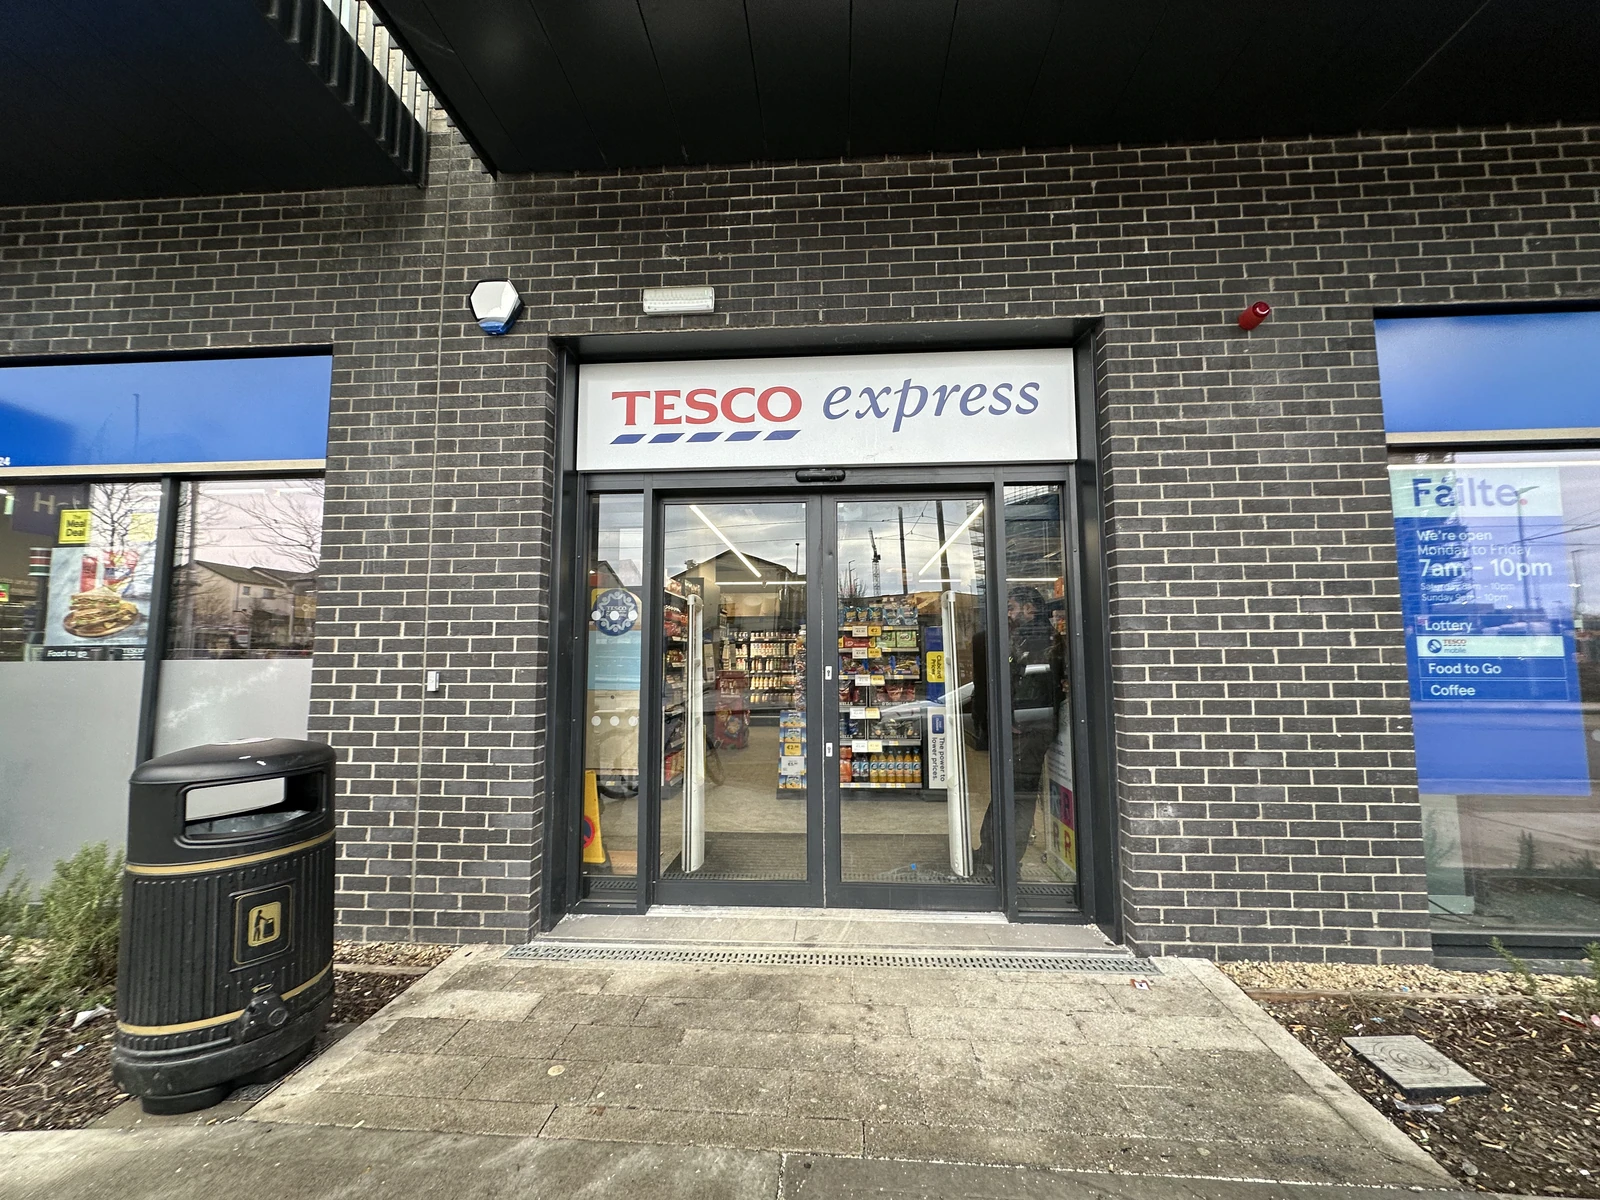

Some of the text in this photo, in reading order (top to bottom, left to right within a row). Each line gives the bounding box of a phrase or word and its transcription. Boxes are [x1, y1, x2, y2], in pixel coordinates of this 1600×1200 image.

[611, 378, 1040, 433] TESCO express
[66, 519, 87, 528] Meal
[65, 528, 85, 537] Deal
[1416, 530, 1493, 544] We're open
[1417, 544, 1532, 557] Monday to Friday
[1419, 558, 1466, 577] 7am
[1490, 558, 1553, 581] 10pm
[1421, 593, 1454, 602] Sunday
[1484, 592, 1509, 602] 10pm
[1424, 620, 1473, 634] Lottery
[46, 649, 67, 658] Food
[1428, 662, 1502, 674] Food to Go
[1430, 684, 1476, 696] Coffee
[939, 774, 945, 782] to
